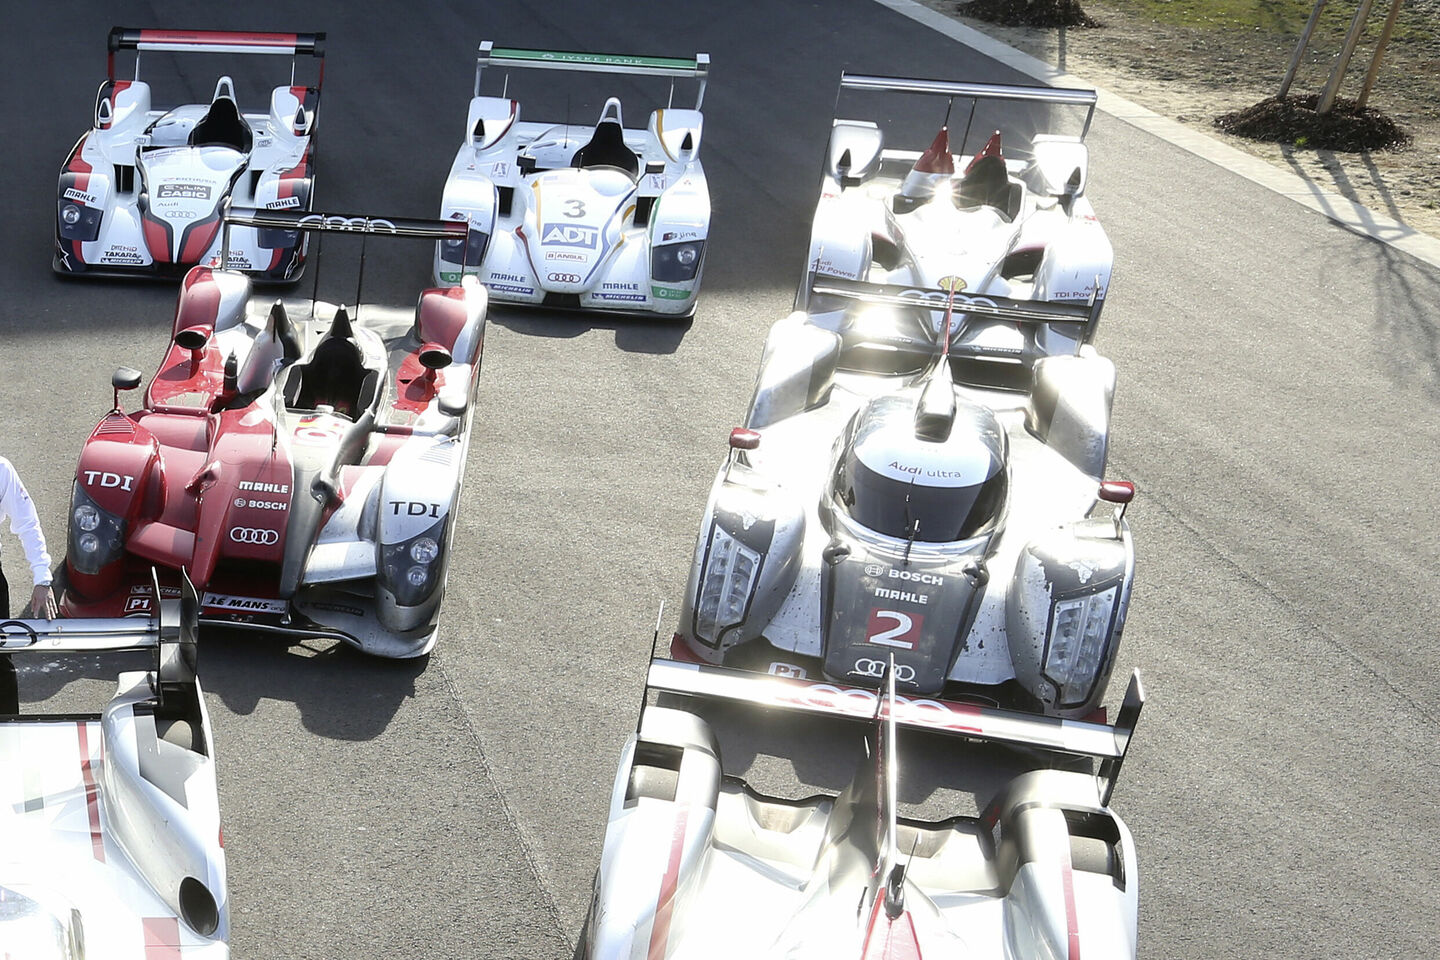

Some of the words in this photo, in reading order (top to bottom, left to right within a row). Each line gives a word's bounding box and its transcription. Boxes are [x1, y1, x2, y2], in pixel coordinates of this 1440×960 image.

[66, 189, 97, 203] MAHLE
[161, 190, 207, 198] CASIO
[266, 198, 299, 209] MAHLE
[563, 199, 586, 218] 3
[546, 225, 598, 247] ADT
[490, 272, 526, 283] MAHLE
[826, 267, 857, 279] Power
[493, 284, 533, 293] MICHELIN
[888, 460, 922, 476] Audi
[926, 468, 961, 478] ultra
[84, 470, 135, 492] TDI
[238, 480, 289, 494] MAHLE
[248, 500, 288, 511] BOSCH
[389, 501, 441, 519] TDI
[888, 568, 944, 586] BOSCH
[209, 595, 226, 605] LE
[228, 599, 270, 610] MANS
[874, 587, 928, 604] MAHLE
[130, 599, 150, 609] P1
[869, 610, 914, 650] 2
